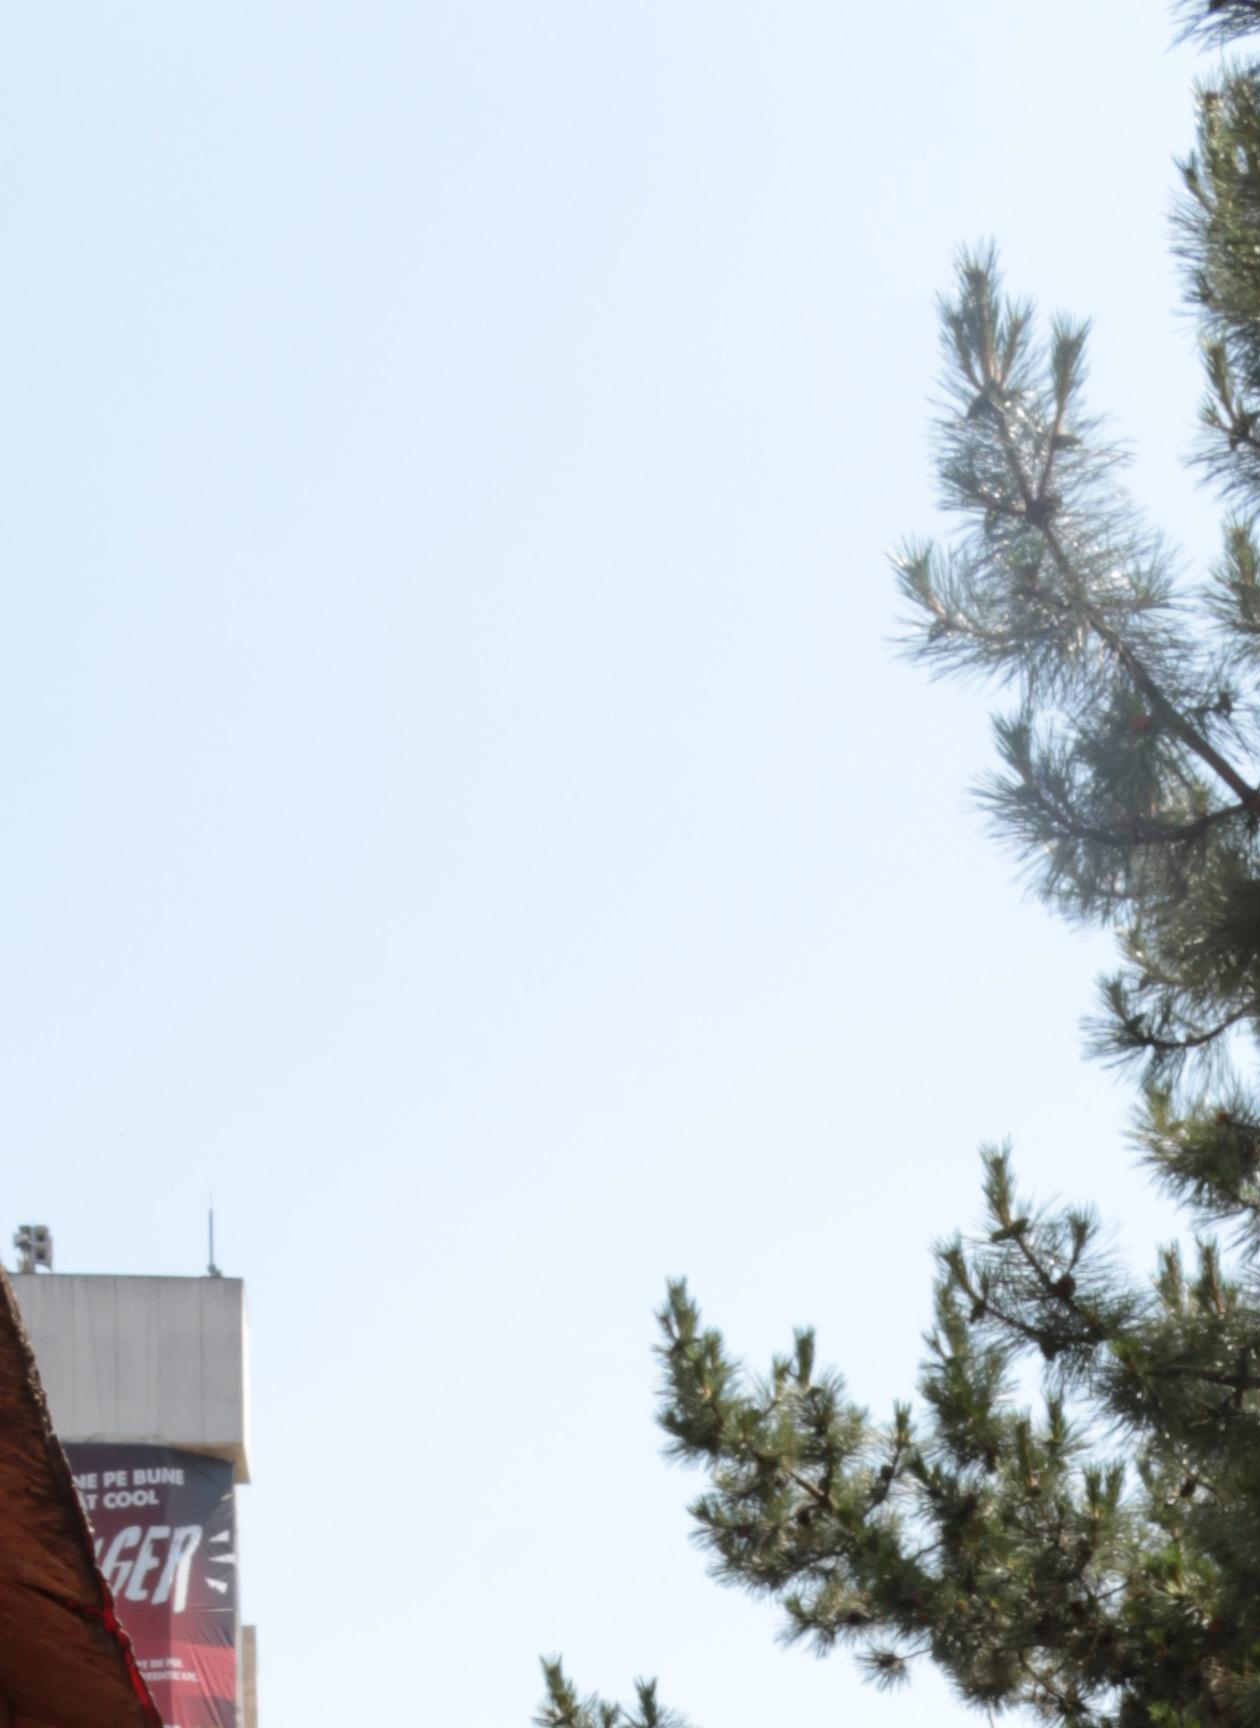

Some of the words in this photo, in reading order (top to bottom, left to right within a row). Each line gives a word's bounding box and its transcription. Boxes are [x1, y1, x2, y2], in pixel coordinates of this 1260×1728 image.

[103, 1470, 128, 1488] PE
[133, 1468, 184, 1486] BUNE
[103, 1490, 159, 1509] COOL
[95, 1524, 203, 1614] GER
